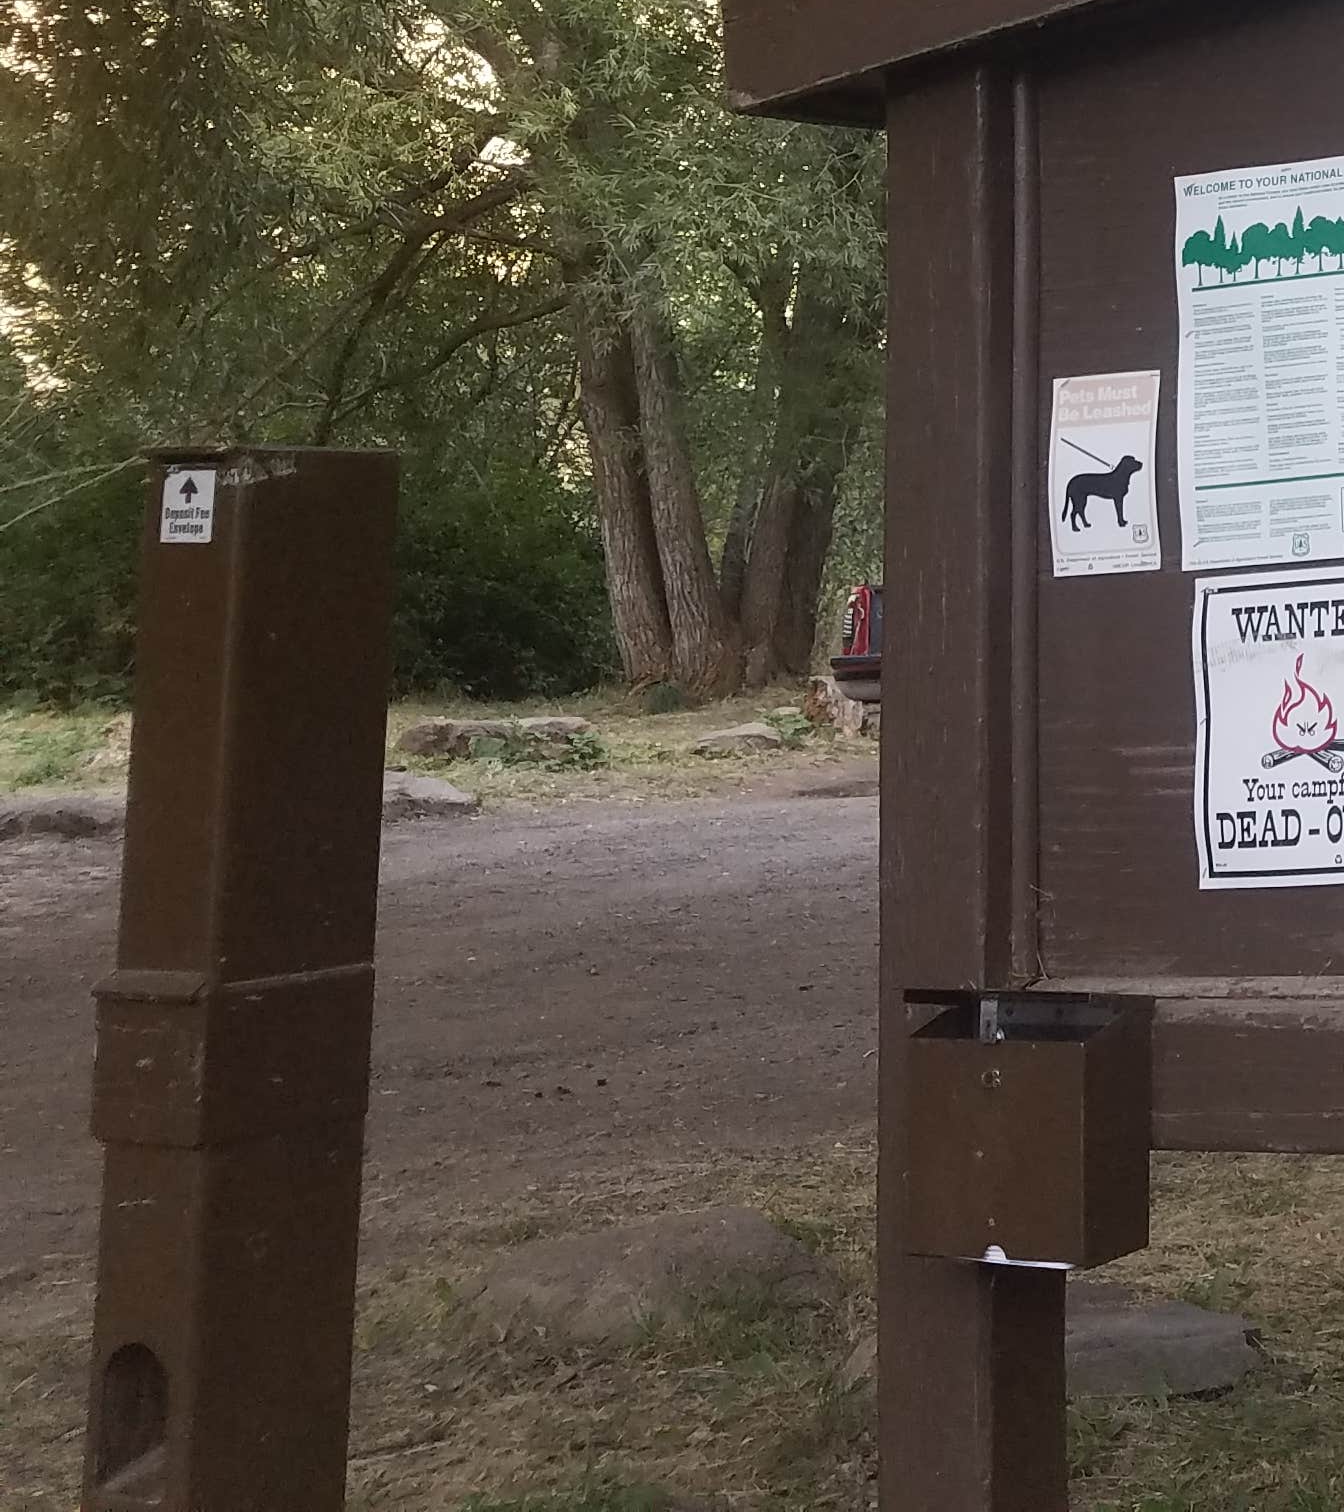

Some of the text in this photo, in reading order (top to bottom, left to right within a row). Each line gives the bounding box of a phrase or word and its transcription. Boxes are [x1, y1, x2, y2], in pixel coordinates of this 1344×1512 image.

[1184, 183, 1236, 197] WELCOME
[1240, 179, 1253, 189] TO
[1257, 175, 1287, 188] YOUR
[1291, 168, 1342, 183] NATIONAL
[1059, 386, 1137, 404] Pets Must
[1058, 400, 1151, 422] Be Leashed
[165, 507, 210, 522] Deposit Fee
[169, 522, 203, 535] Envelope
[1242, 777, 1286, 802] Your
